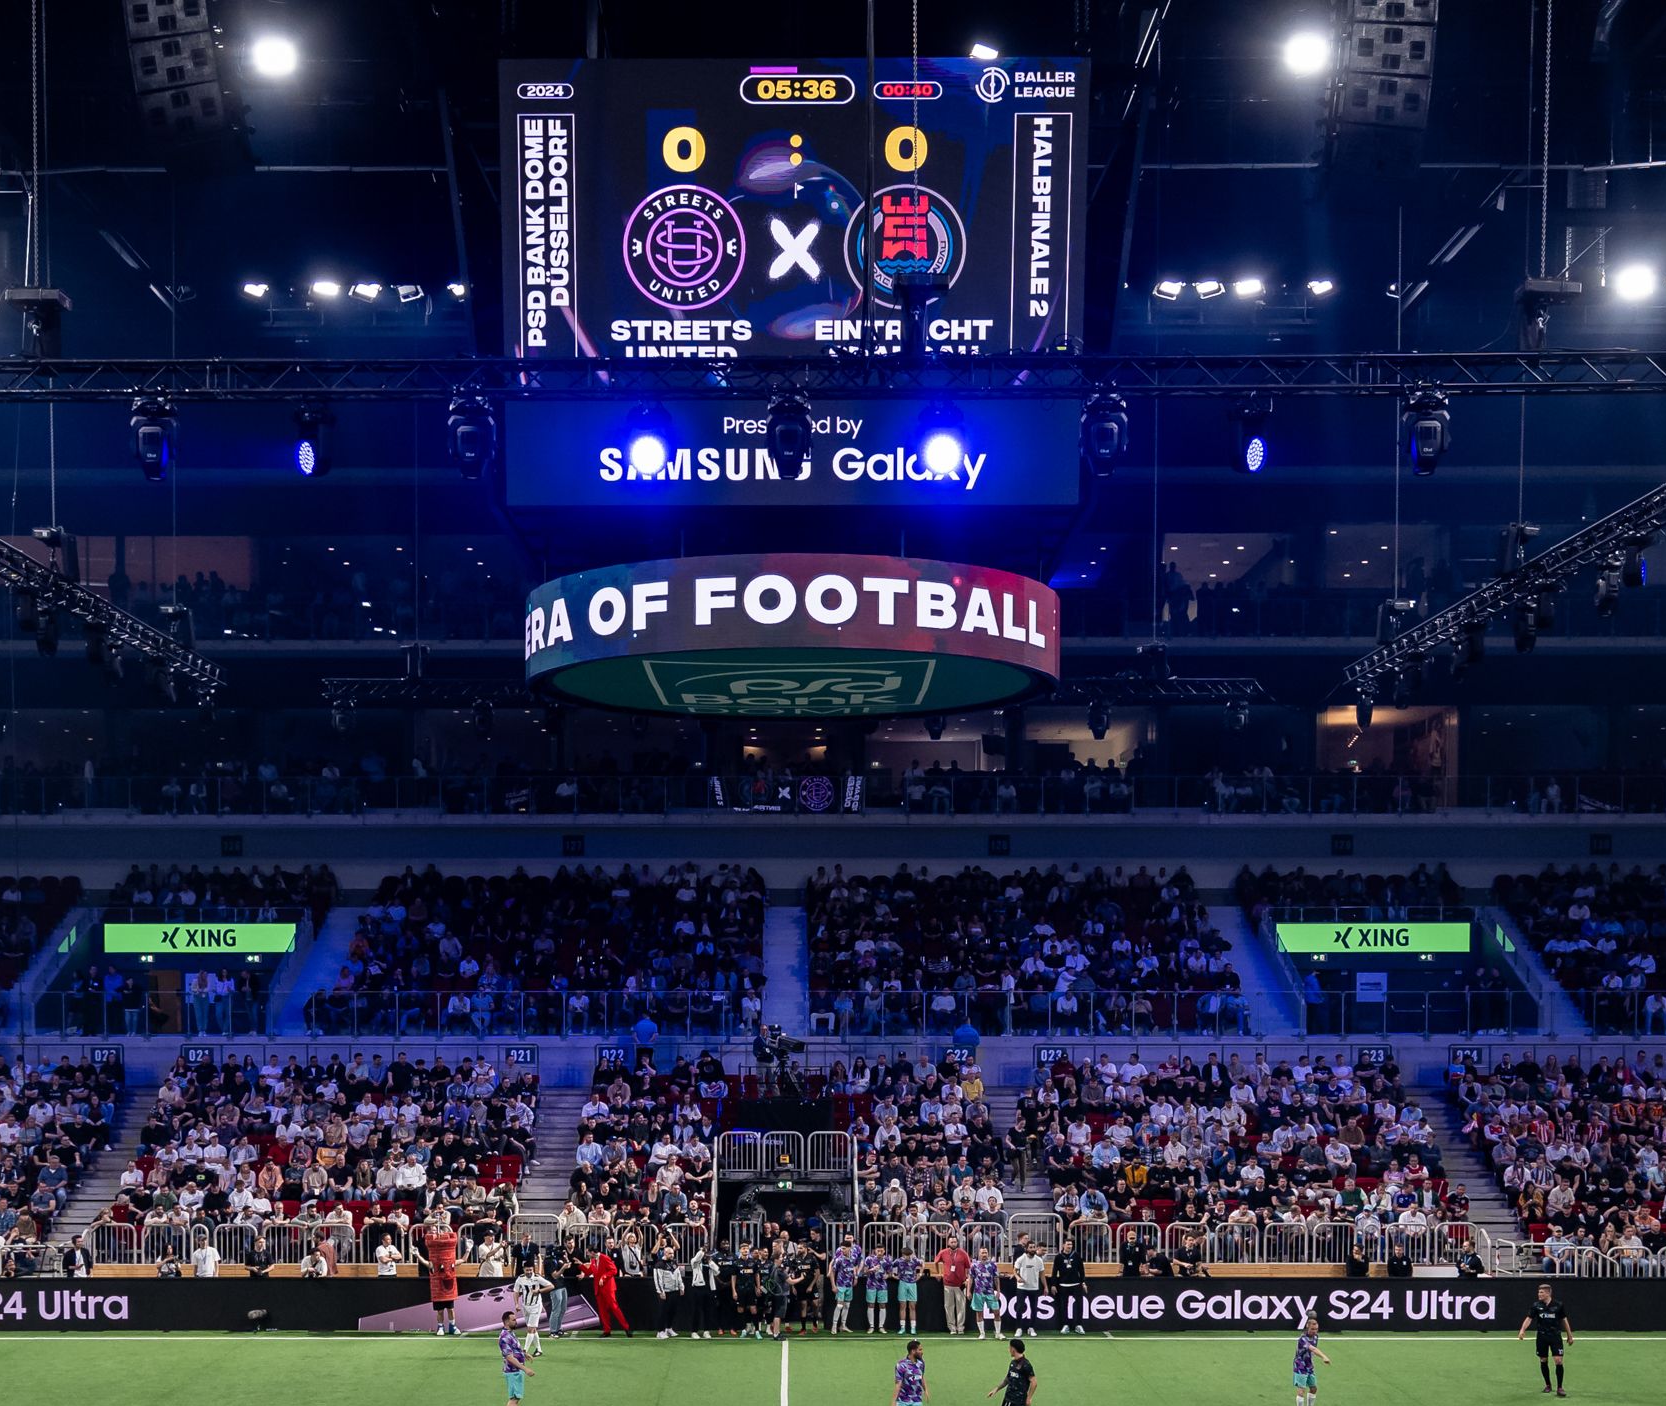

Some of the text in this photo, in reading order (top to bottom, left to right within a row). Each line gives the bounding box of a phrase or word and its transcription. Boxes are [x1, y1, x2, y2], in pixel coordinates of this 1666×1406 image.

[1014, 71, 1076, 83] BALLER
[526, 85, 565, 98] 2024
[757, 80, 837, 99] 05:36
[883, 84, 933, 97] 00:40
[1014, 86, 1076, 98] LEAGUE
[662, 126, 706, 173] 0
[884, 126, 928, 173] 0
[545, 119, 570, 307] DÜSSELDORF
[643, 193, 724, 221] STREETS
[1029, 116, 1053, 318] HALBFINALE 2
[524, 118, 547, 347] PSD BANK DOME
[649, 279, 720, 302] UNITED
[611, 319, 753, 341] STREETS
[815, 319, 994, 341] EINTRCHT
[723, 415, 863, 437] Presed by
[588, 580, 669, 637] OF
[694, 573, 1046, 648] FOOTBALL
[729, 665, 903, 695] psd
[681, 693, 898, 706] Bank
[185, 927, 237, 948] XING
[1359, 927, 1411, 948] XING
[947, 1049, 969, 1062] 22
[1363, 1049, 1385, 1062] 23
[38, 1290, 128, 1321] Ultra
[1067, 1294, 1166, 1320] neue
[1175, 1289, 1318, 1329] Galaxy
[1327, 1289, 1394, 1320] S24
[1406, 1289, 1496, 1320] Ultra
